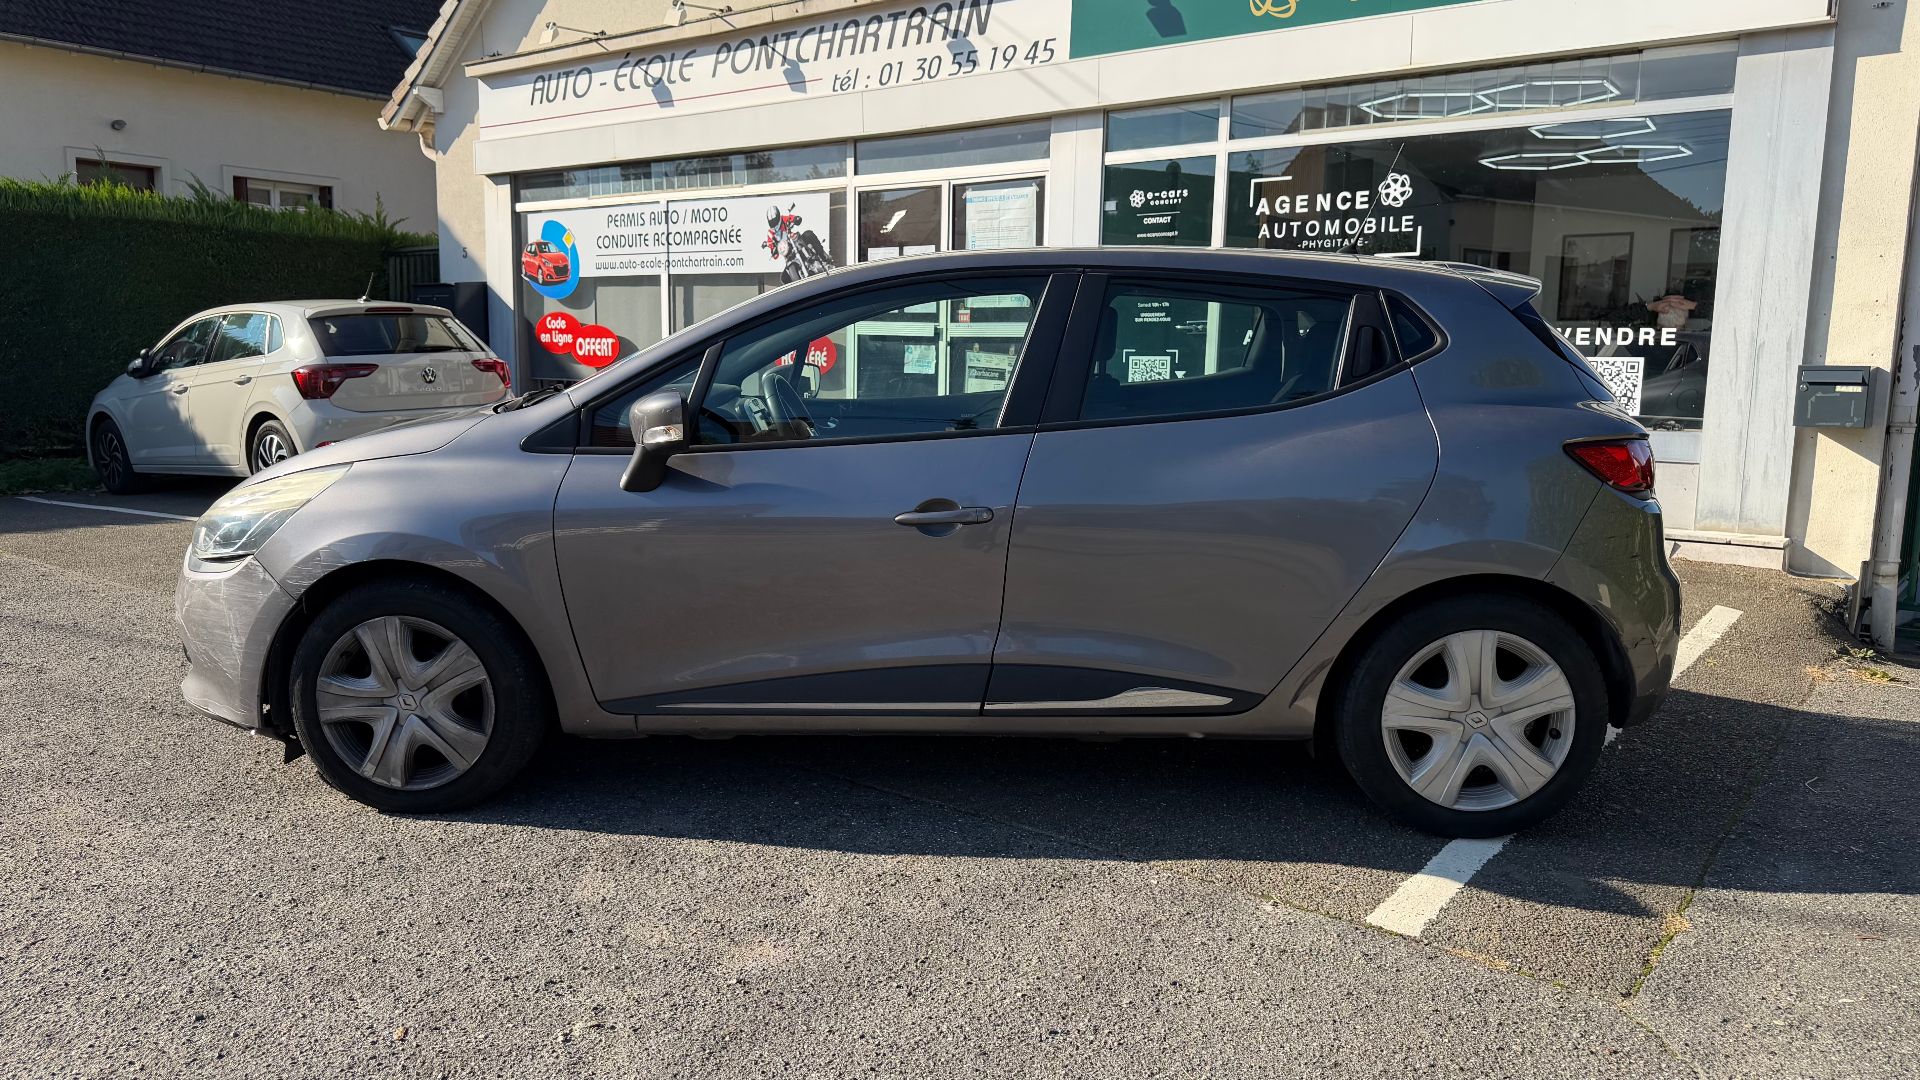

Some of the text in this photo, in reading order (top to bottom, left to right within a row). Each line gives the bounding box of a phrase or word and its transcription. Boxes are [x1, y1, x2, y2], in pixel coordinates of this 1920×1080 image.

[530, 66, 593, 106] AUTO
[613, 49, 696, 92] ÉCOLE
[711, 0, 995, 78] PONTCHARTRAIN
[832, 67, 860, 93] tél
[878, 60, 903, 86] 01
[912, 55, 942, 82] 30
[948, 50, 978, 77] 55
[989, 44, 1018, 70] 19
[1024, 38, 1057, 64] 45
[1146, 188, 1189, 200] e-cars
[1255, 190, 1370, 216] AGENCE
[607, 212, 646, 229] PERMIS
[650, 210, 680, 226] AUTO
[691, 206, 728, 224] MOTO
[1143, 216, 1172, 225] CONTACT
[1258, 215, 1415, 240] AUTOMOBILE
[596, 225, 742, 250] CONDUITE ACCOMPAGNÉE
[462, 246, 468, 259] 5
[595, 255, 744, 272] www.auto-ecole-pontchartrain.com
[546, 316, 567, 329] Code
[540, 331, 574, 346] en Ligne
[1557, 327, 1678, 346] VENDRE
[575, 338, 615, 357] OFFERT
